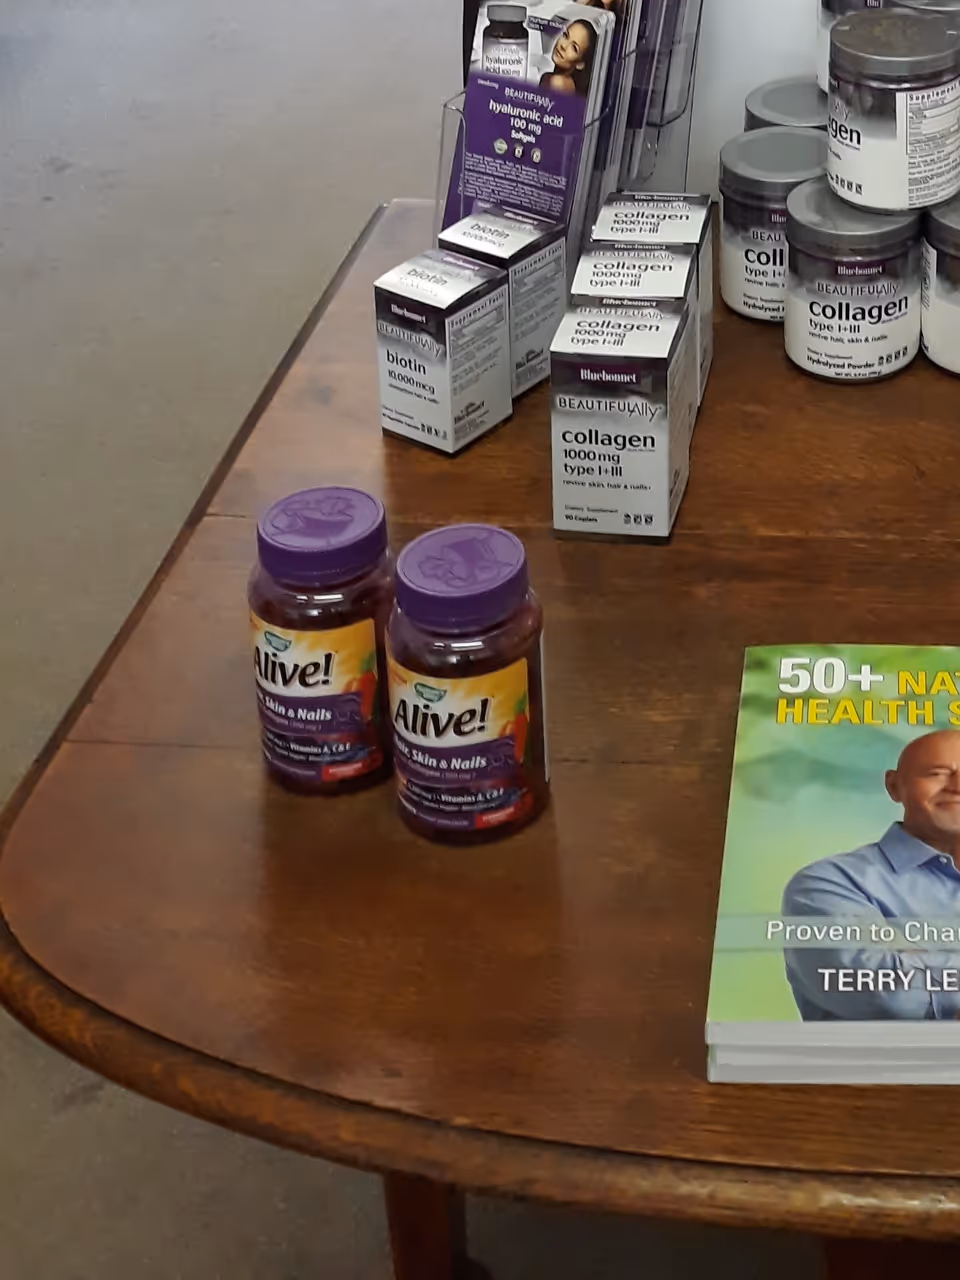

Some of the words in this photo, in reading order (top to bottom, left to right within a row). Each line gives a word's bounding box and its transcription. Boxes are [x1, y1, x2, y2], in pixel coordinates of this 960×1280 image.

[909, 84, 957, 102] Supplement
[489, 99, 541, 122] hyaluronic
[543, 114, 564, 128] acid
[510, 116, 526, 130] 100
[528, 123, 542, 136] mg
[614, 211, 690, 222] collagen
[469, 222, 510, 240] biotin
[610, 226, 636, 234] type
[752, 231, 781, 242] BEAU
[744, 248, 784, 266] coll
[593, 261, 673, 273] collagen
[745, 265, 768, 277] type
[407, 268, 448, 287] biotin
[590, 278, 617, 287] type
[809, 295, 908, 325] collagen
[576, 320, 661, 332] collagen
[809, 318, 834, 332] type
[838, 324, 860, 333] I+III
[571, 336, 600, 346] type
[386, 349, 426, 375] biotin
[847, 362, 876, 370] Powder
[580, 368, 637, 383] Bluebonnet
[562, 429, 656, 450] collagen
[564, 463, 595, 477] type
[598, 465, 622, 477] I+III
[563, 479, 586, 487] revive
[607, 481, 622, 489] hair
[254, 645, 335, 688] Alive!
[777, 656, 884, 695] 50+
[265, 697, 286, 716] Skin
[287, 709, 296, 718] &
[297, 707, 333, 721] Nails
[394, 697, 491, 739] Alive!
[775, 698, 934, 726] HEALTH
[290, 742, 322, 754] Vitamins
[412, 748, 437, 769] Skin
[439, 759, 448, 769] &
[450, 755, 488, 770] Nails
[441, 791, 476, 804] Vitamins
[765, 921, 862, 942] Proven
[869, 922, 896, 942] to
[817, 967, 917, 992] TERRY
